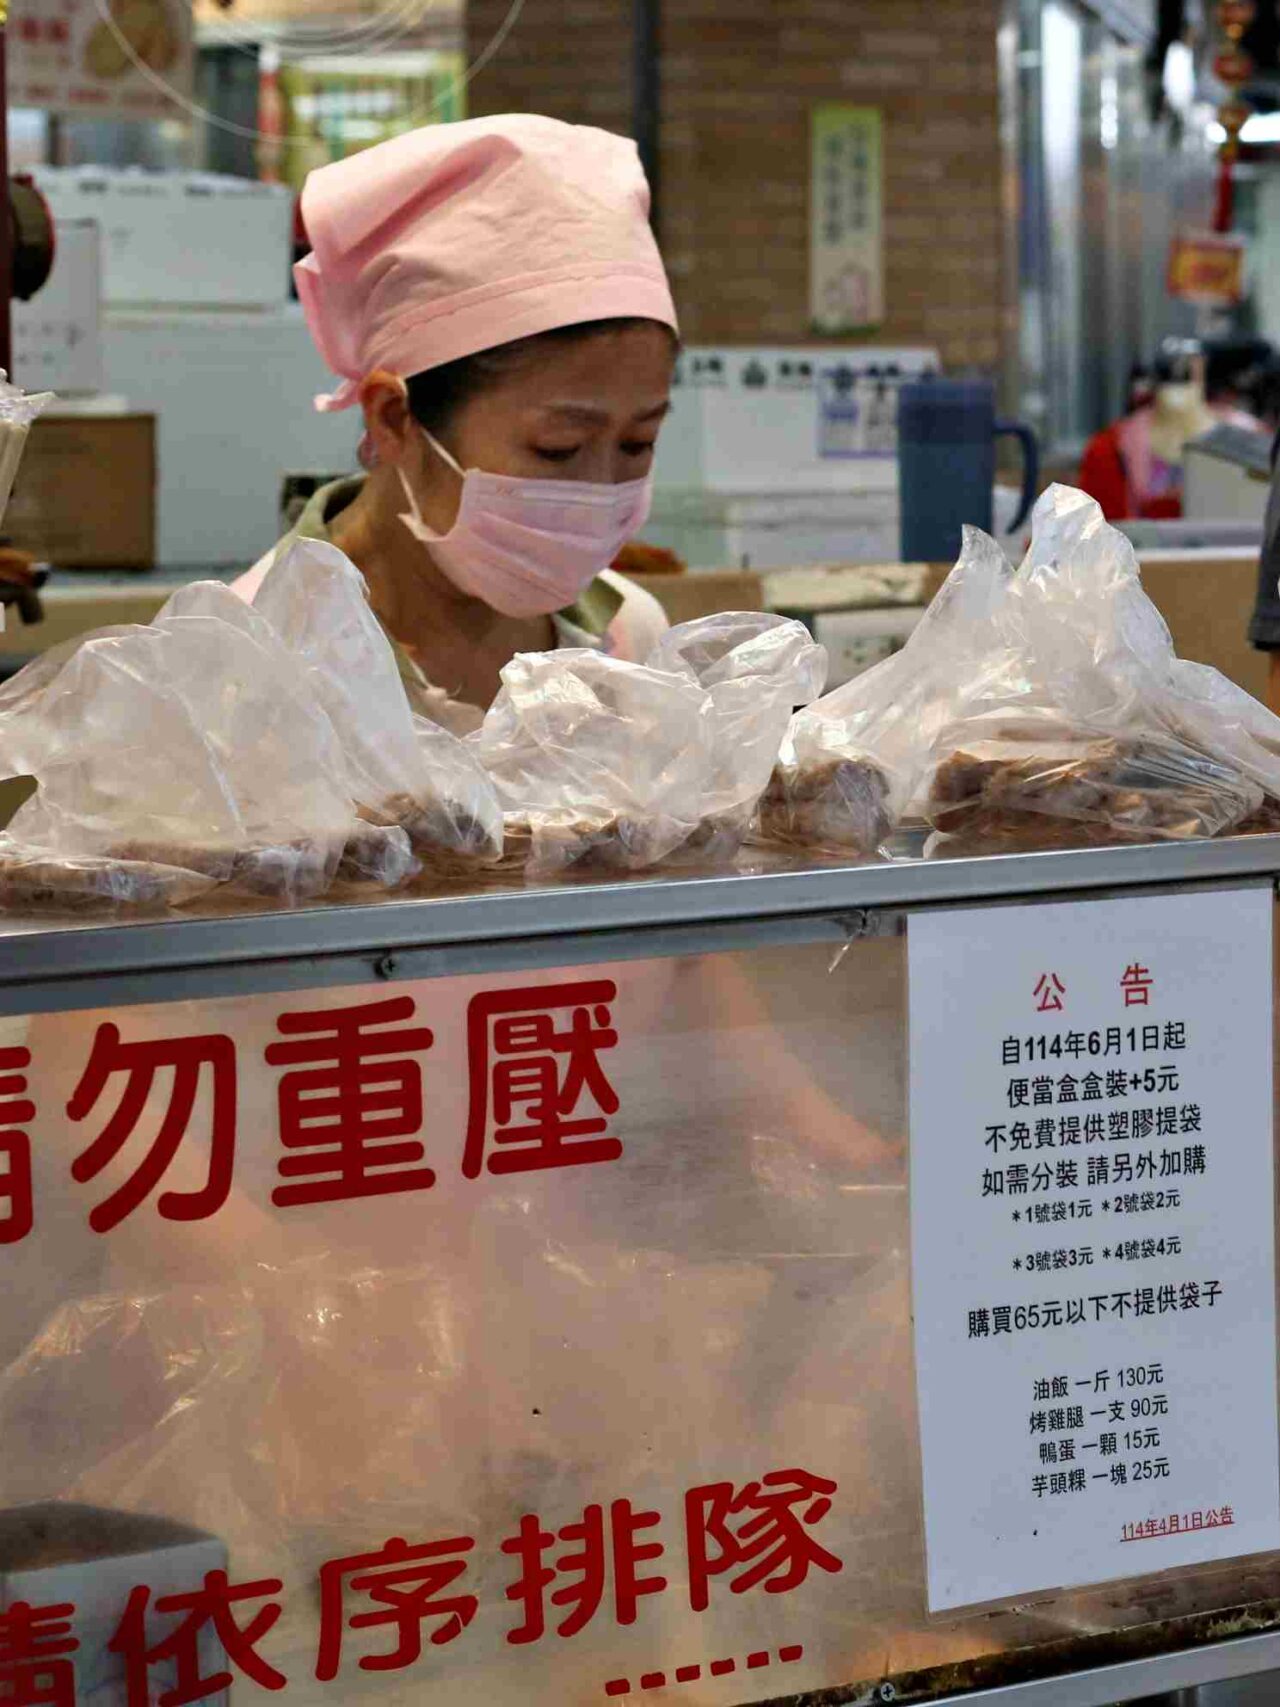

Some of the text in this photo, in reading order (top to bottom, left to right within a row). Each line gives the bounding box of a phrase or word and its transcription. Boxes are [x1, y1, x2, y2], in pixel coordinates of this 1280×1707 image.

[1033, 963, 1153, 1012] 公 告
[1002, 1020, 1187, 1066] 自114年6月1日起
[1007, 1065, 1180, 1108] 便當盒盒裝+5元
[0, 979, 622, 1243] 勿重壓
[985, 1104, 1202, 1154] 不免費提供塑膠提袋
[981, 1144, 1207, 1198] 如需分裝 請另外加購
[967, 1280, 1223, 1340] 購買65元以下不提供袋子
[1033, 1363, 1164, 1402] 油飯 一斤 130元
[1029, 1394, 1169, 1435] 烤雞腿 一支 90元
[1039, 1426, 1161, 1466] 鴨蛋 一顆 15元
[1031, 1456, 1171, 1499] 芋頭粿 一塊 25元
[1120, 1506, 1235, 1541] 114年4月1日公告
